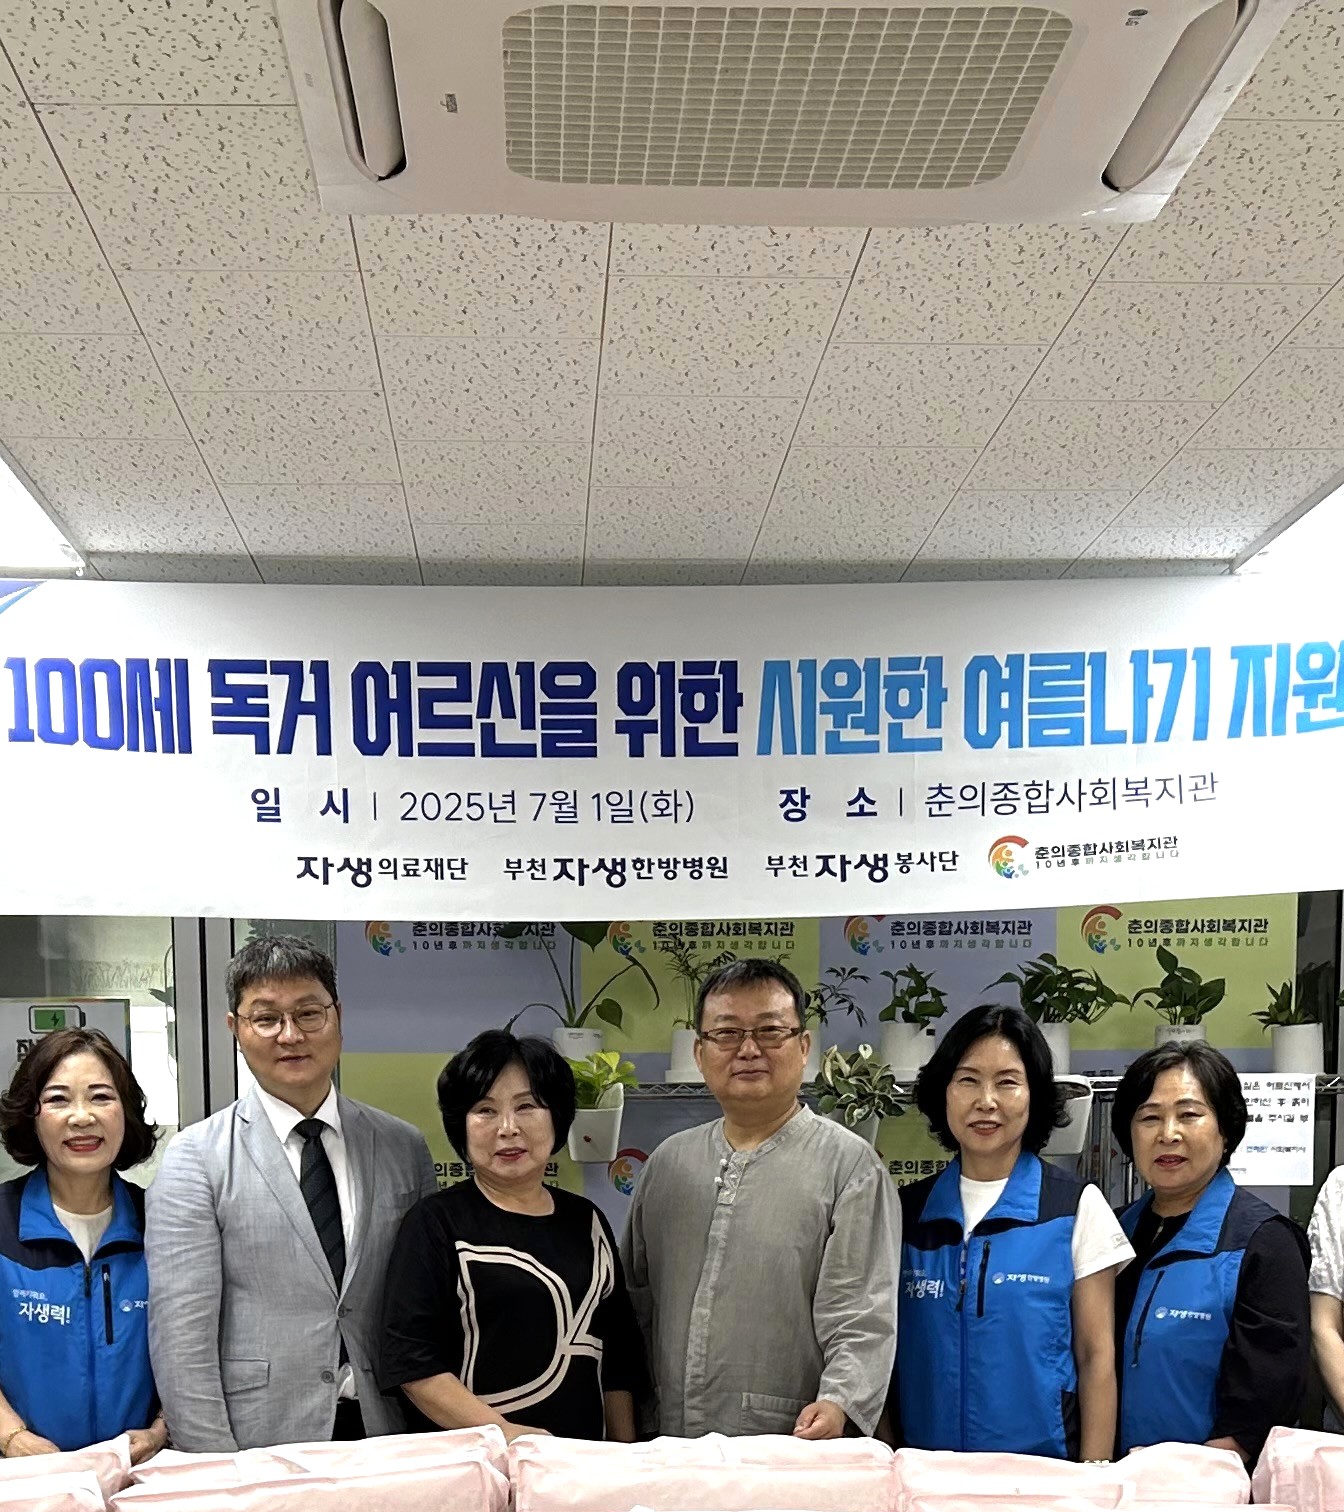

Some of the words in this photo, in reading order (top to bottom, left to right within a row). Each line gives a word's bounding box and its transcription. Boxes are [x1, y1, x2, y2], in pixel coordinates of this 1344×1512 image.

[5, 655, 193, 755] 100세
[210, 659, 332, 757] 독거
[350, 658, 599, 760] 어르신을
[615, 659, 741, 759] 위한
[756, 655, 946, 758] 시원한
[962, 646, 1212, 752] 여름나기
[250, 787, 283, 824] 일
[320, 787, 351, 824] 시
[399, 789, 517, 825] 2025년
[529, 788, 580, 824] 7월
[593, 787, 695, 825] 1일(화)
[777, 787, 810, 823] 장
[846, 788, 879, 820] 소
[923, 772, 1220, 820] 춘의종합사회복지관
[296, 856, 470, 890] 자생의료재단
[1034, 835, 1178, 860] 춘의종합사회복지관
[890, 919, 1032, 936] 춘의종합사회복지관
[1127, 918, 1269, 935] 춘의종합사회복지관
[904, 1279, 944, 1299] 자생력!
[18, 1302, 70, 1326] 자생력!
